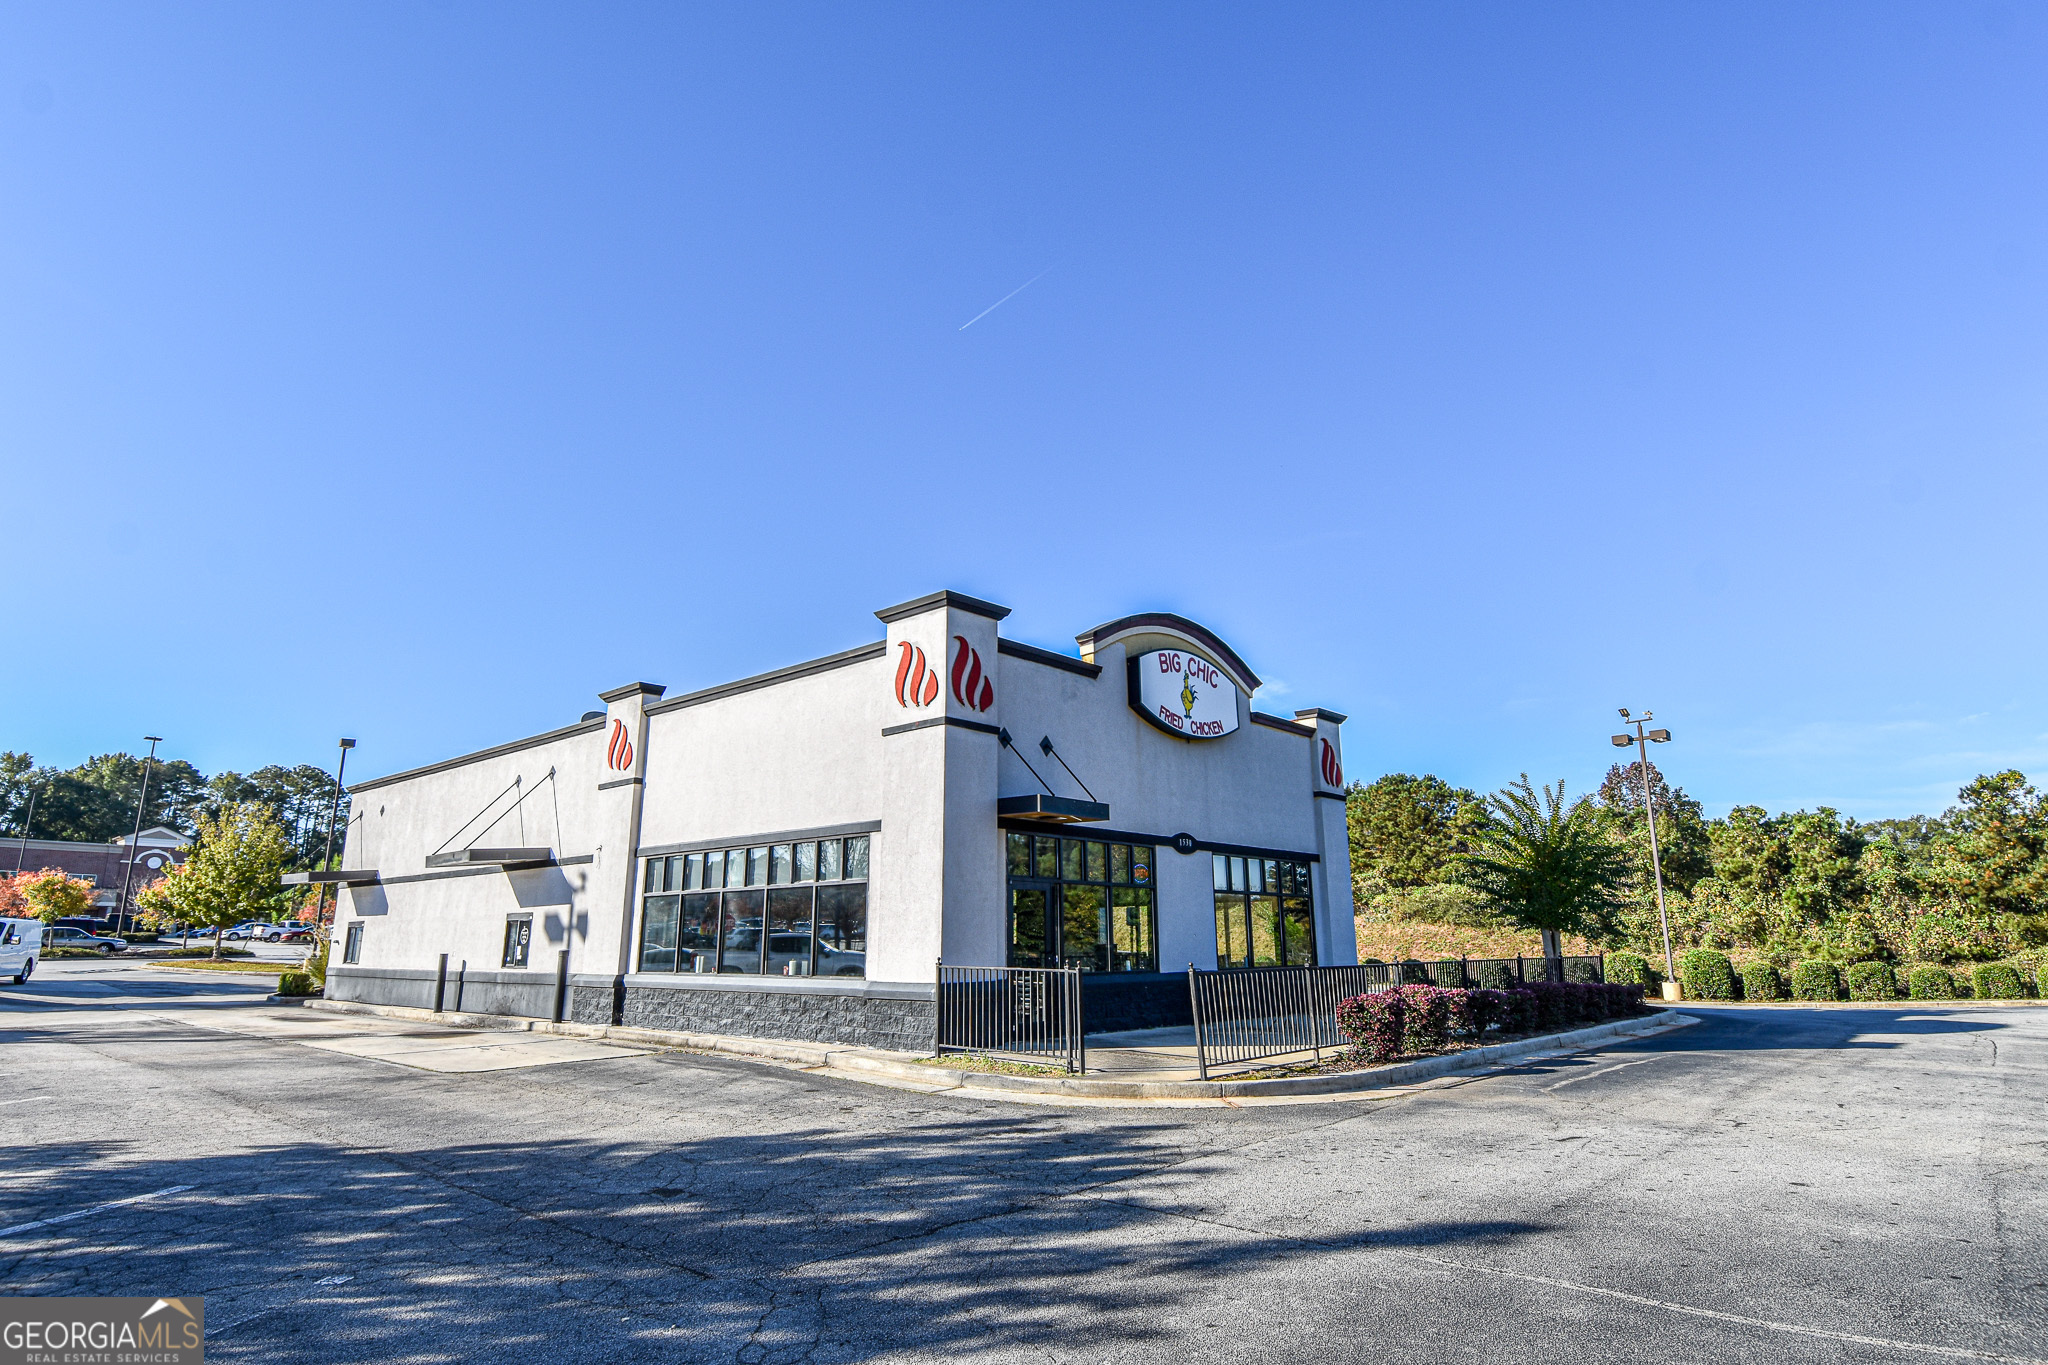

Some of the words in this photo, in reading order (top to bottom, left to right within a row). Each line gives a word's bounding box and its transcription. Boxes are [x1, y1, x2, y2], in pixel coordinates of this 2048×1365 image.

[1158, 653, 1181, 673] BIG
[1187, 657, 1218, 688] CHIC
[1159, 705, 1184, 729] FRIED
[1190, 720, 1224, 735] CHICKEN
